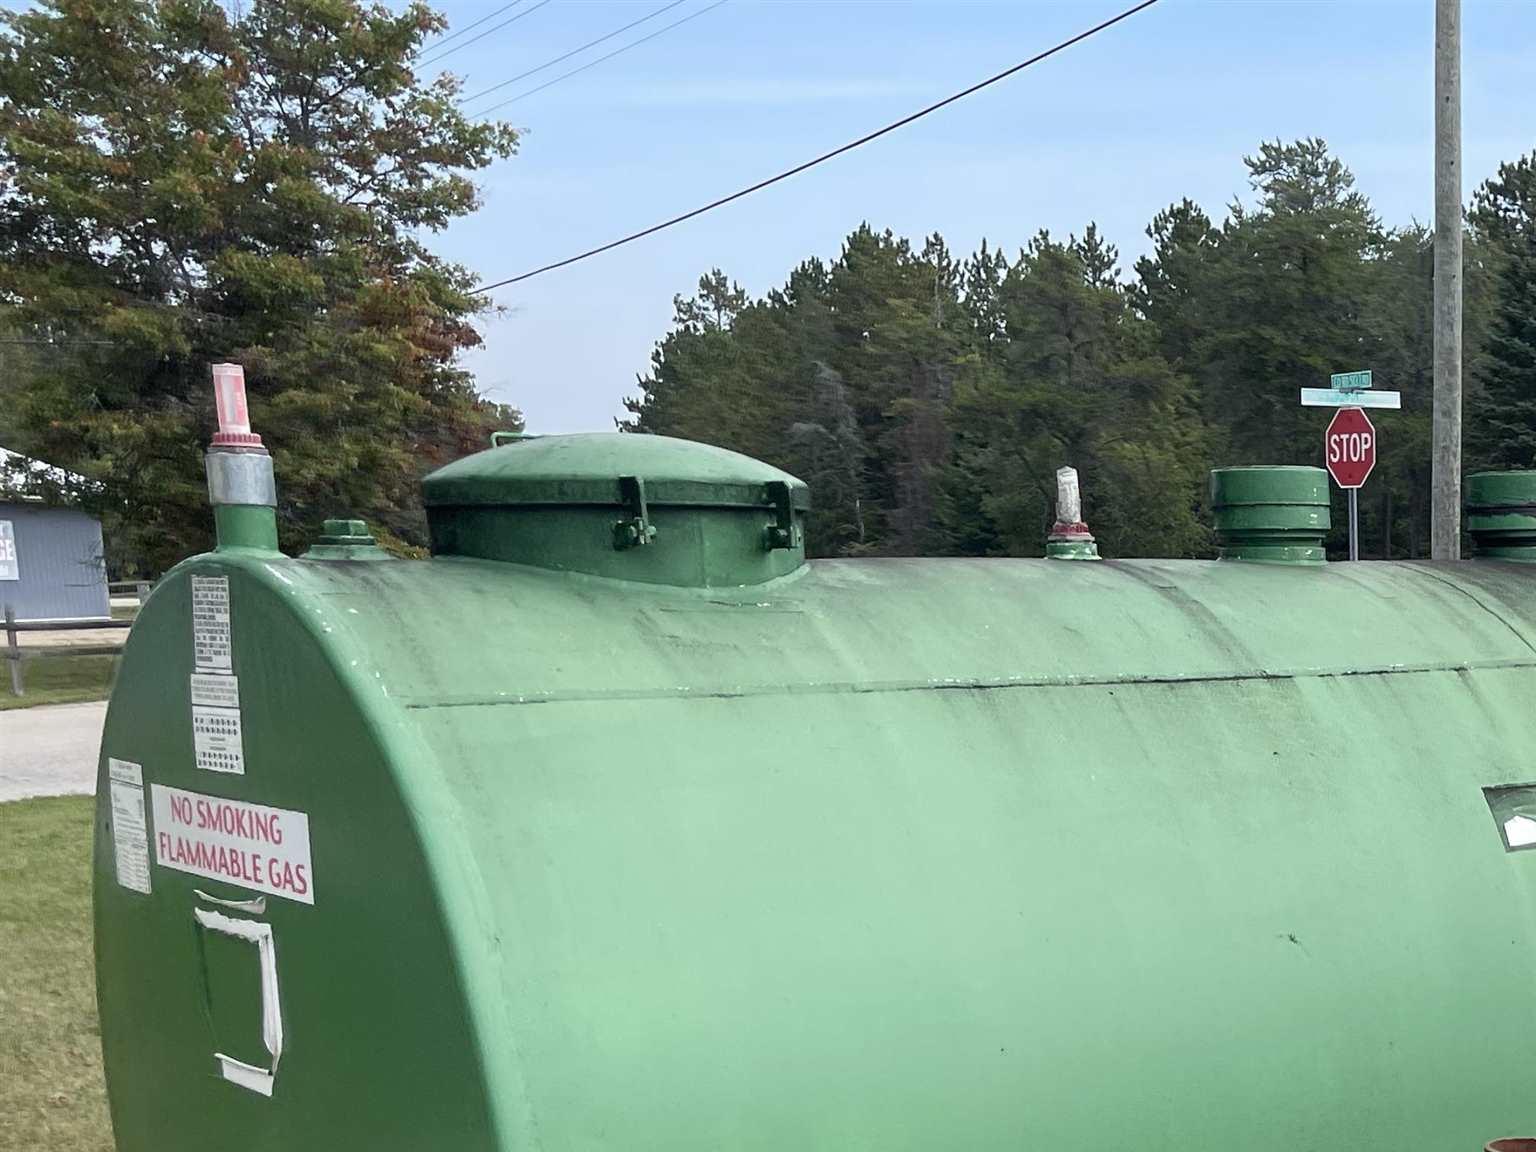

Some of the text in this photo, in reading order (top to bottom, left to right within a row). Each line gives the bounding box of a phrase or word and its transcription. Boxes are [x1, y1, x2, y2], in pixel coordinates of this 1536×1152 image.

[1330, 432, 1371, 463] STOP
[170, 794, 283, 845] NO SMOKING
[159, 832, 264, 884] FLAMMABLE
[268, 858, 308, 895] GAS
